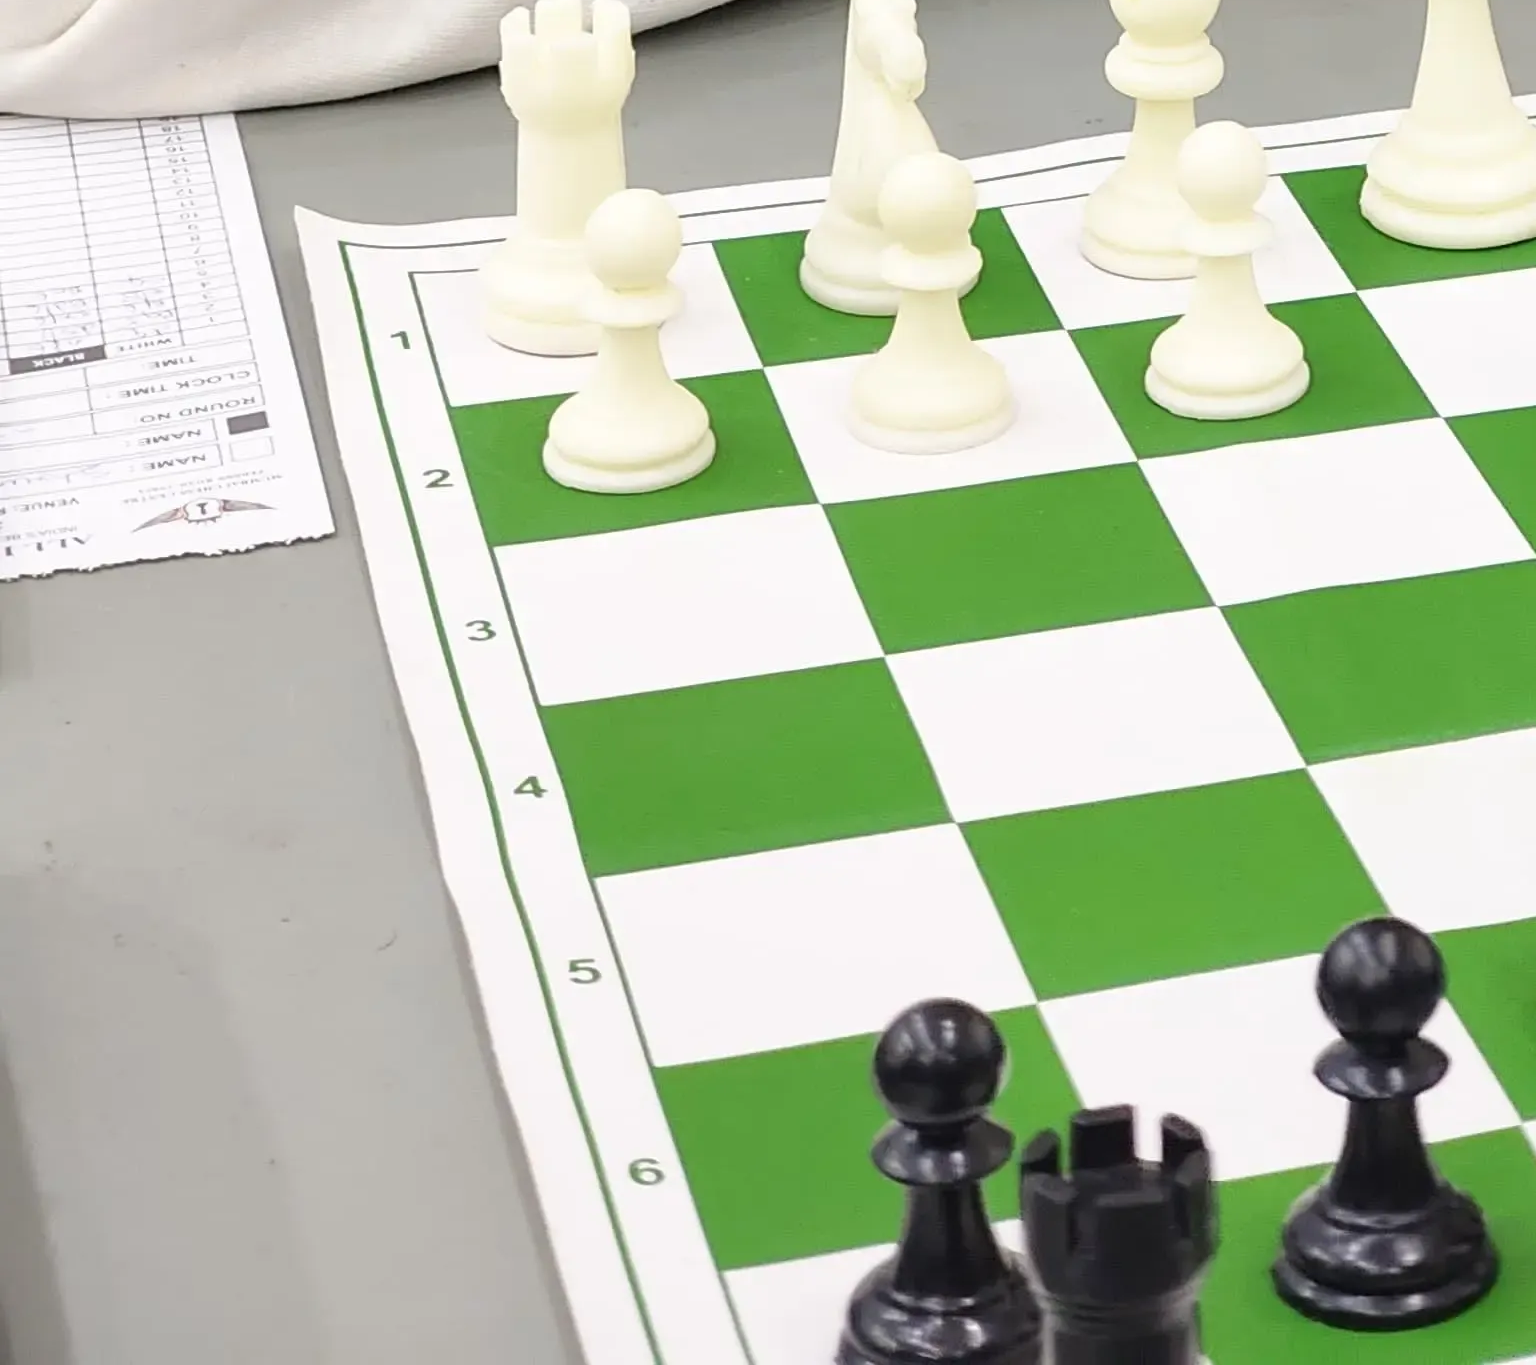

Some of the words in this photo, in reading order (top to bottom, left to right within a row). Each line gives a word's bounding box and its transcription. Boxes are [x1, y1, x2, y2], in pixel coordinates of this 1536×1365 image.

[32, 352, 85, 368] BLACK
[175, 370, 251, 389] CLOCK
[179, 396, 256, 415] ROUND
[423, 468, 454, 489] 2
[465, 619, 497, 642] 3
[513, 775, 548, 799] 4
[568, 958, 602, 985] 5
[628, 1157, 666, 1186] 6
